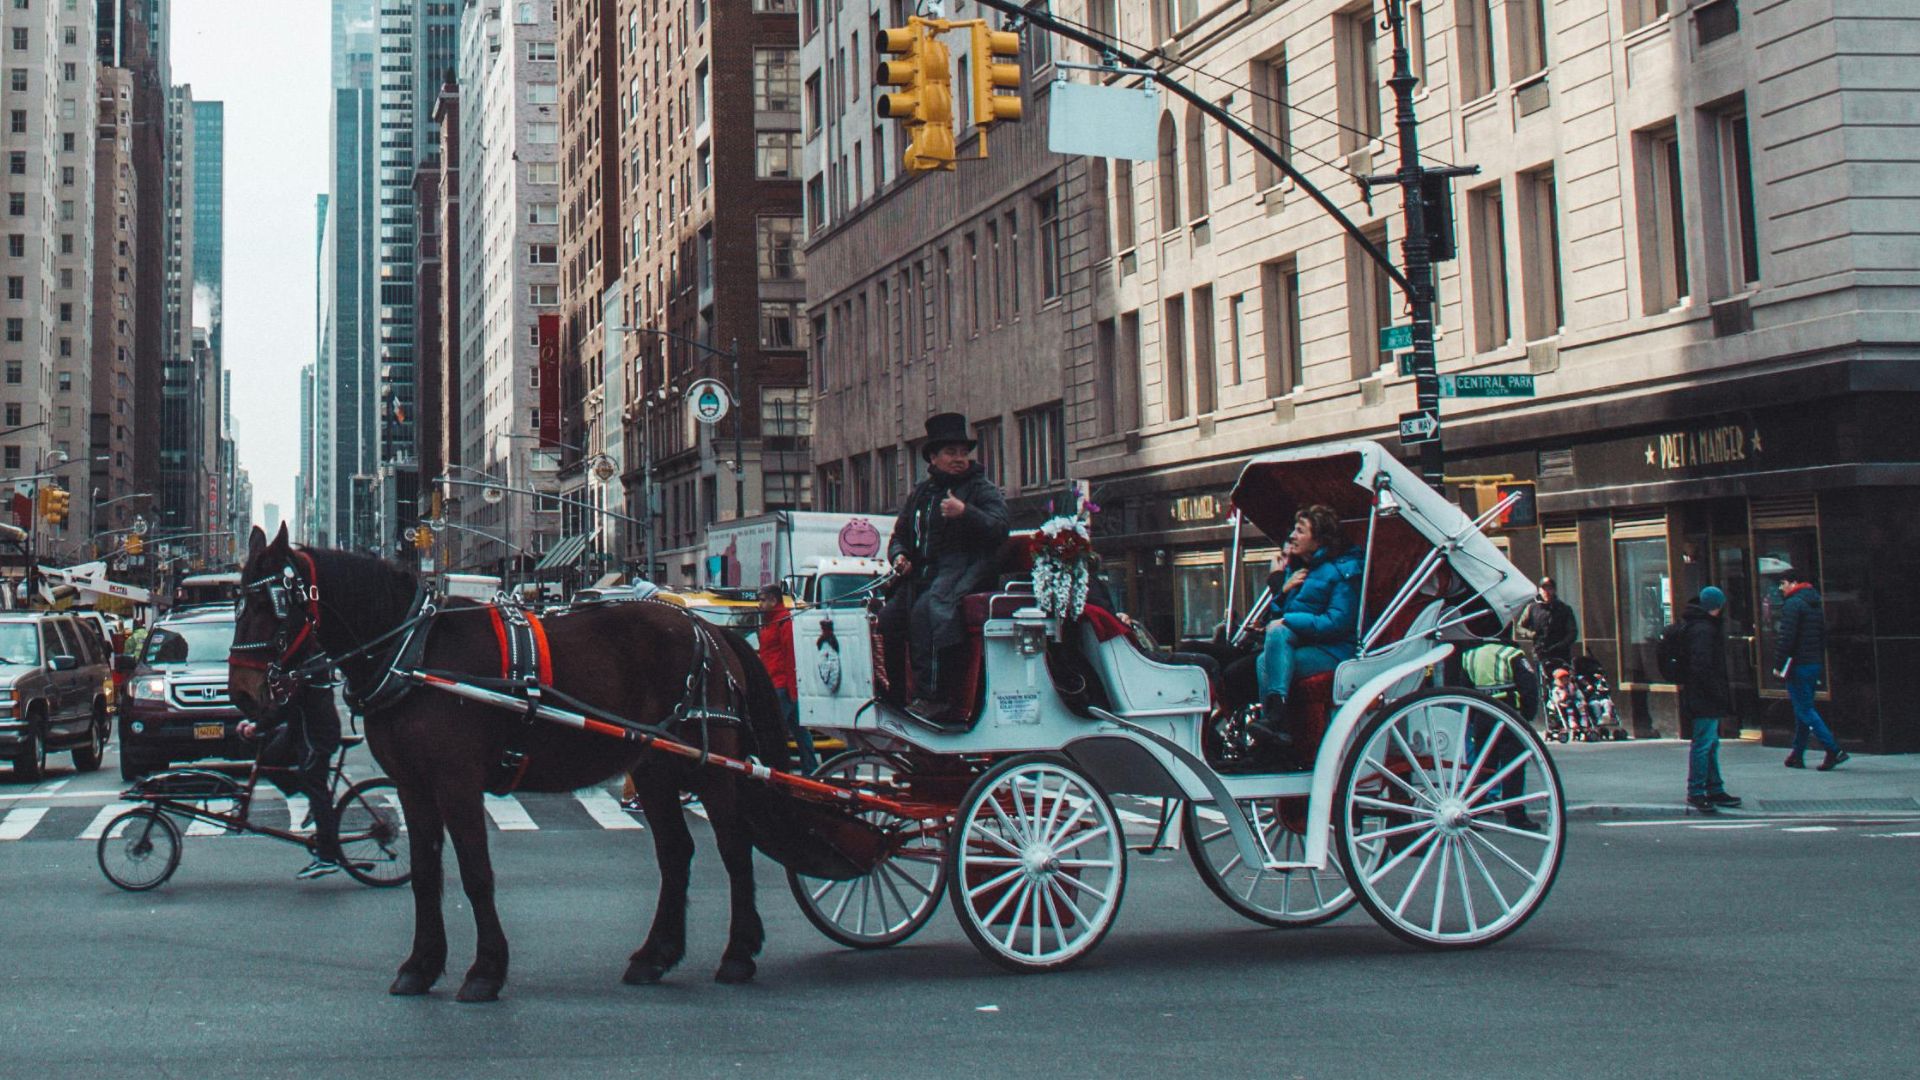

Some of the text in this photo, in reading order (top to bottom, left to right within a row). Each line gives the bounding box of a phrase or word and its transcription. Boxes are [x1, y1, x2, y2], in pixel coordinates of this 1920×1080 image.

[1456, 375, 1533, 389] CENTRAL PARK
[1402, 418, 1432, 434] ONE WAY
[1660, 425, 1745, 469] PRET A MANGER
